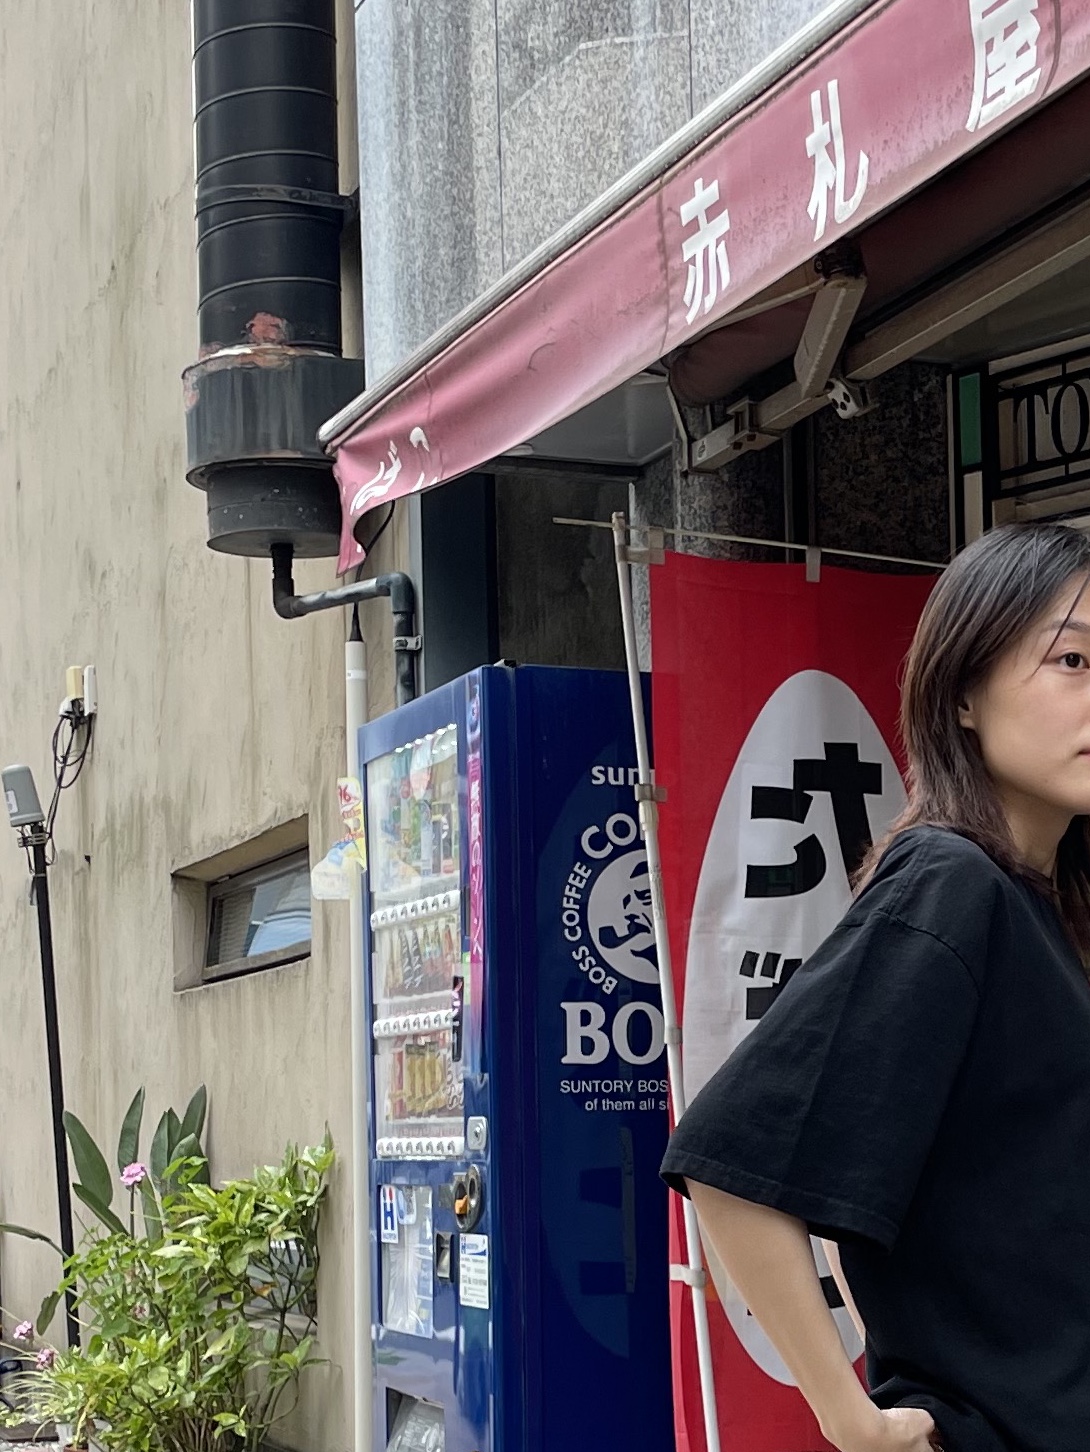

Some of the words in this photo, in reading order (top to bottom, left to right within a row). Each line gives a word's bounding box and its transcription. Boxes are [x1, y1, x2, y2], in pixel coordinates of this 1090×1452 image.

[562, 861, 592, 942] COFFEE
[572, 945, 618, 995] BOSS
[560, 1080, 633, 1094] SUNTORY
[637, 1080, 669, 1094] BOS
[585, 1098, 599, 1111] of
[602, 1098, 635, 1111] them
[639, 1098, 655, 1111] all
